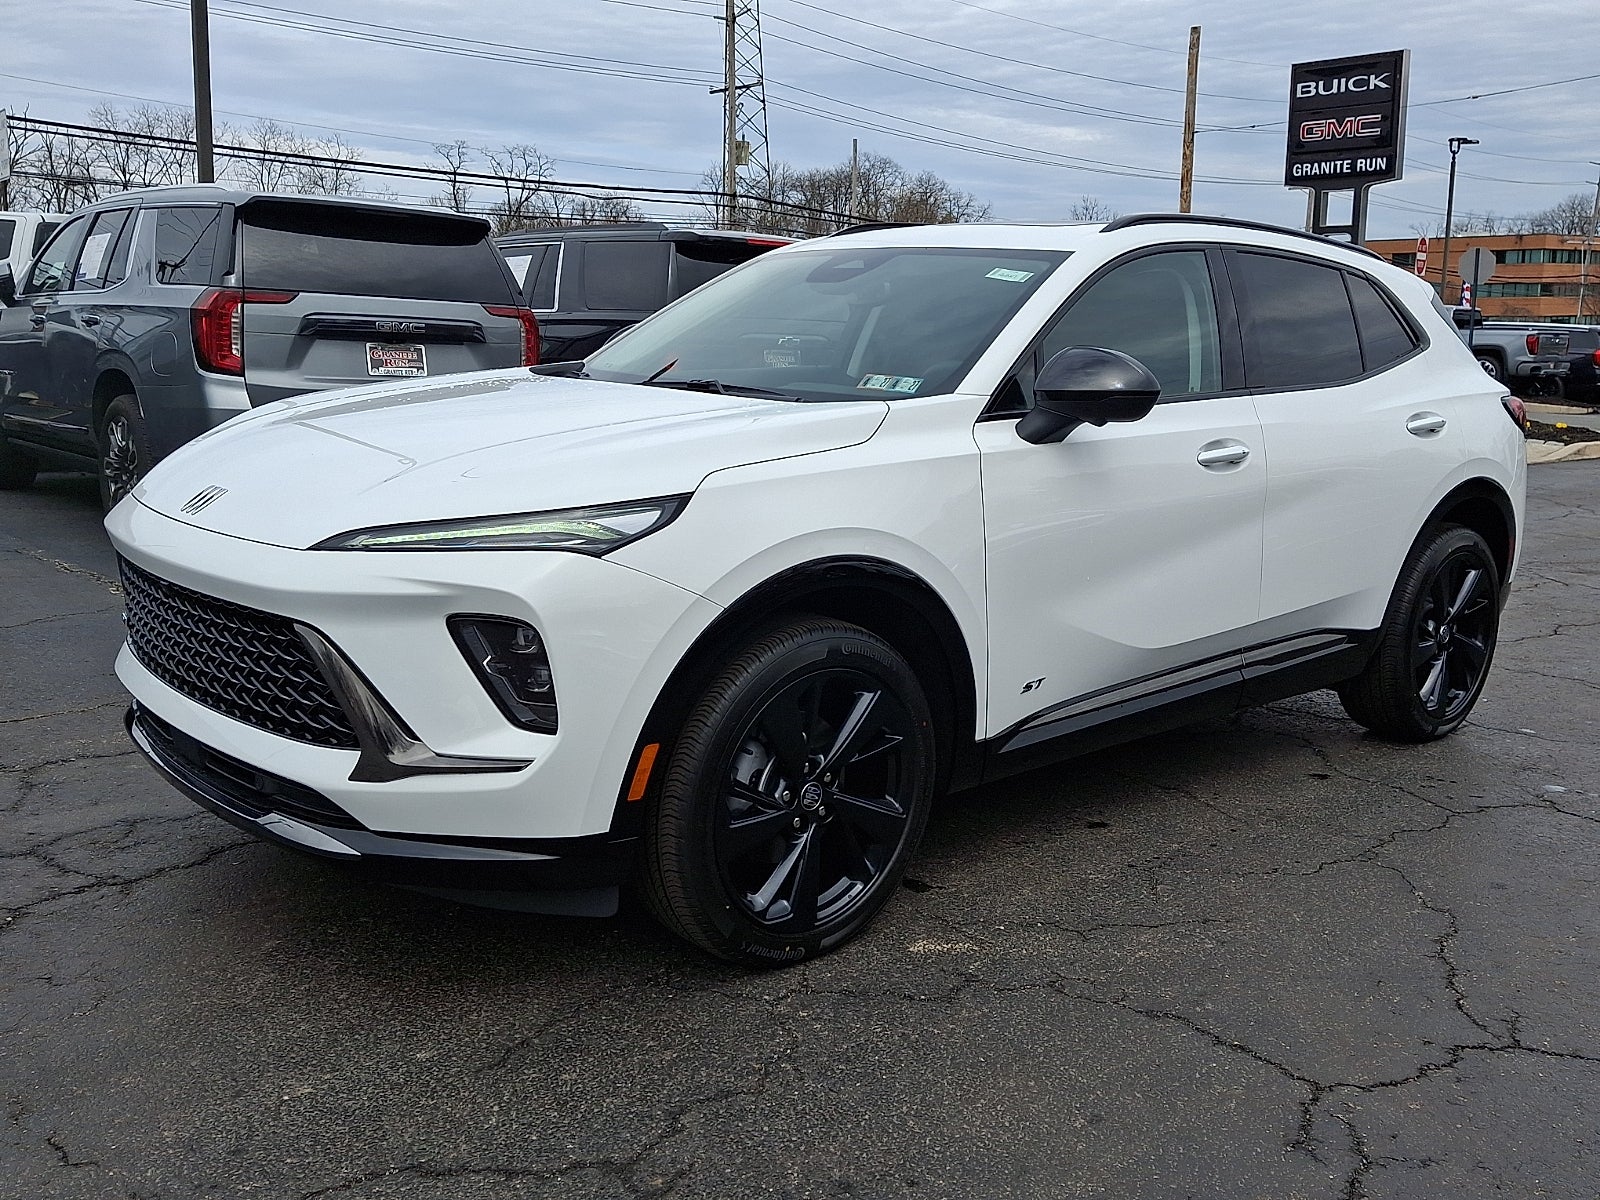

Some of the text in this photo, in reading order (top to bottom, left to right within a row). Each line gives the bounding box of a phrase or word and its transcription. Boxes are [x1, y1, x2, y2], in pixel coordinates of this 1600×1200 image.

[1296, 72, 1391, 98] BUICK
[1300, 114, 1381, 142] GMC
[1292, 157, 1387, 177] GRANITE RUN
[375, 321, 426, 334] GMC
[370, 349, 418, 360] GRANITE
[383, 358, 409, 368] RUN
[1020, 677, 1047, 695] ST
